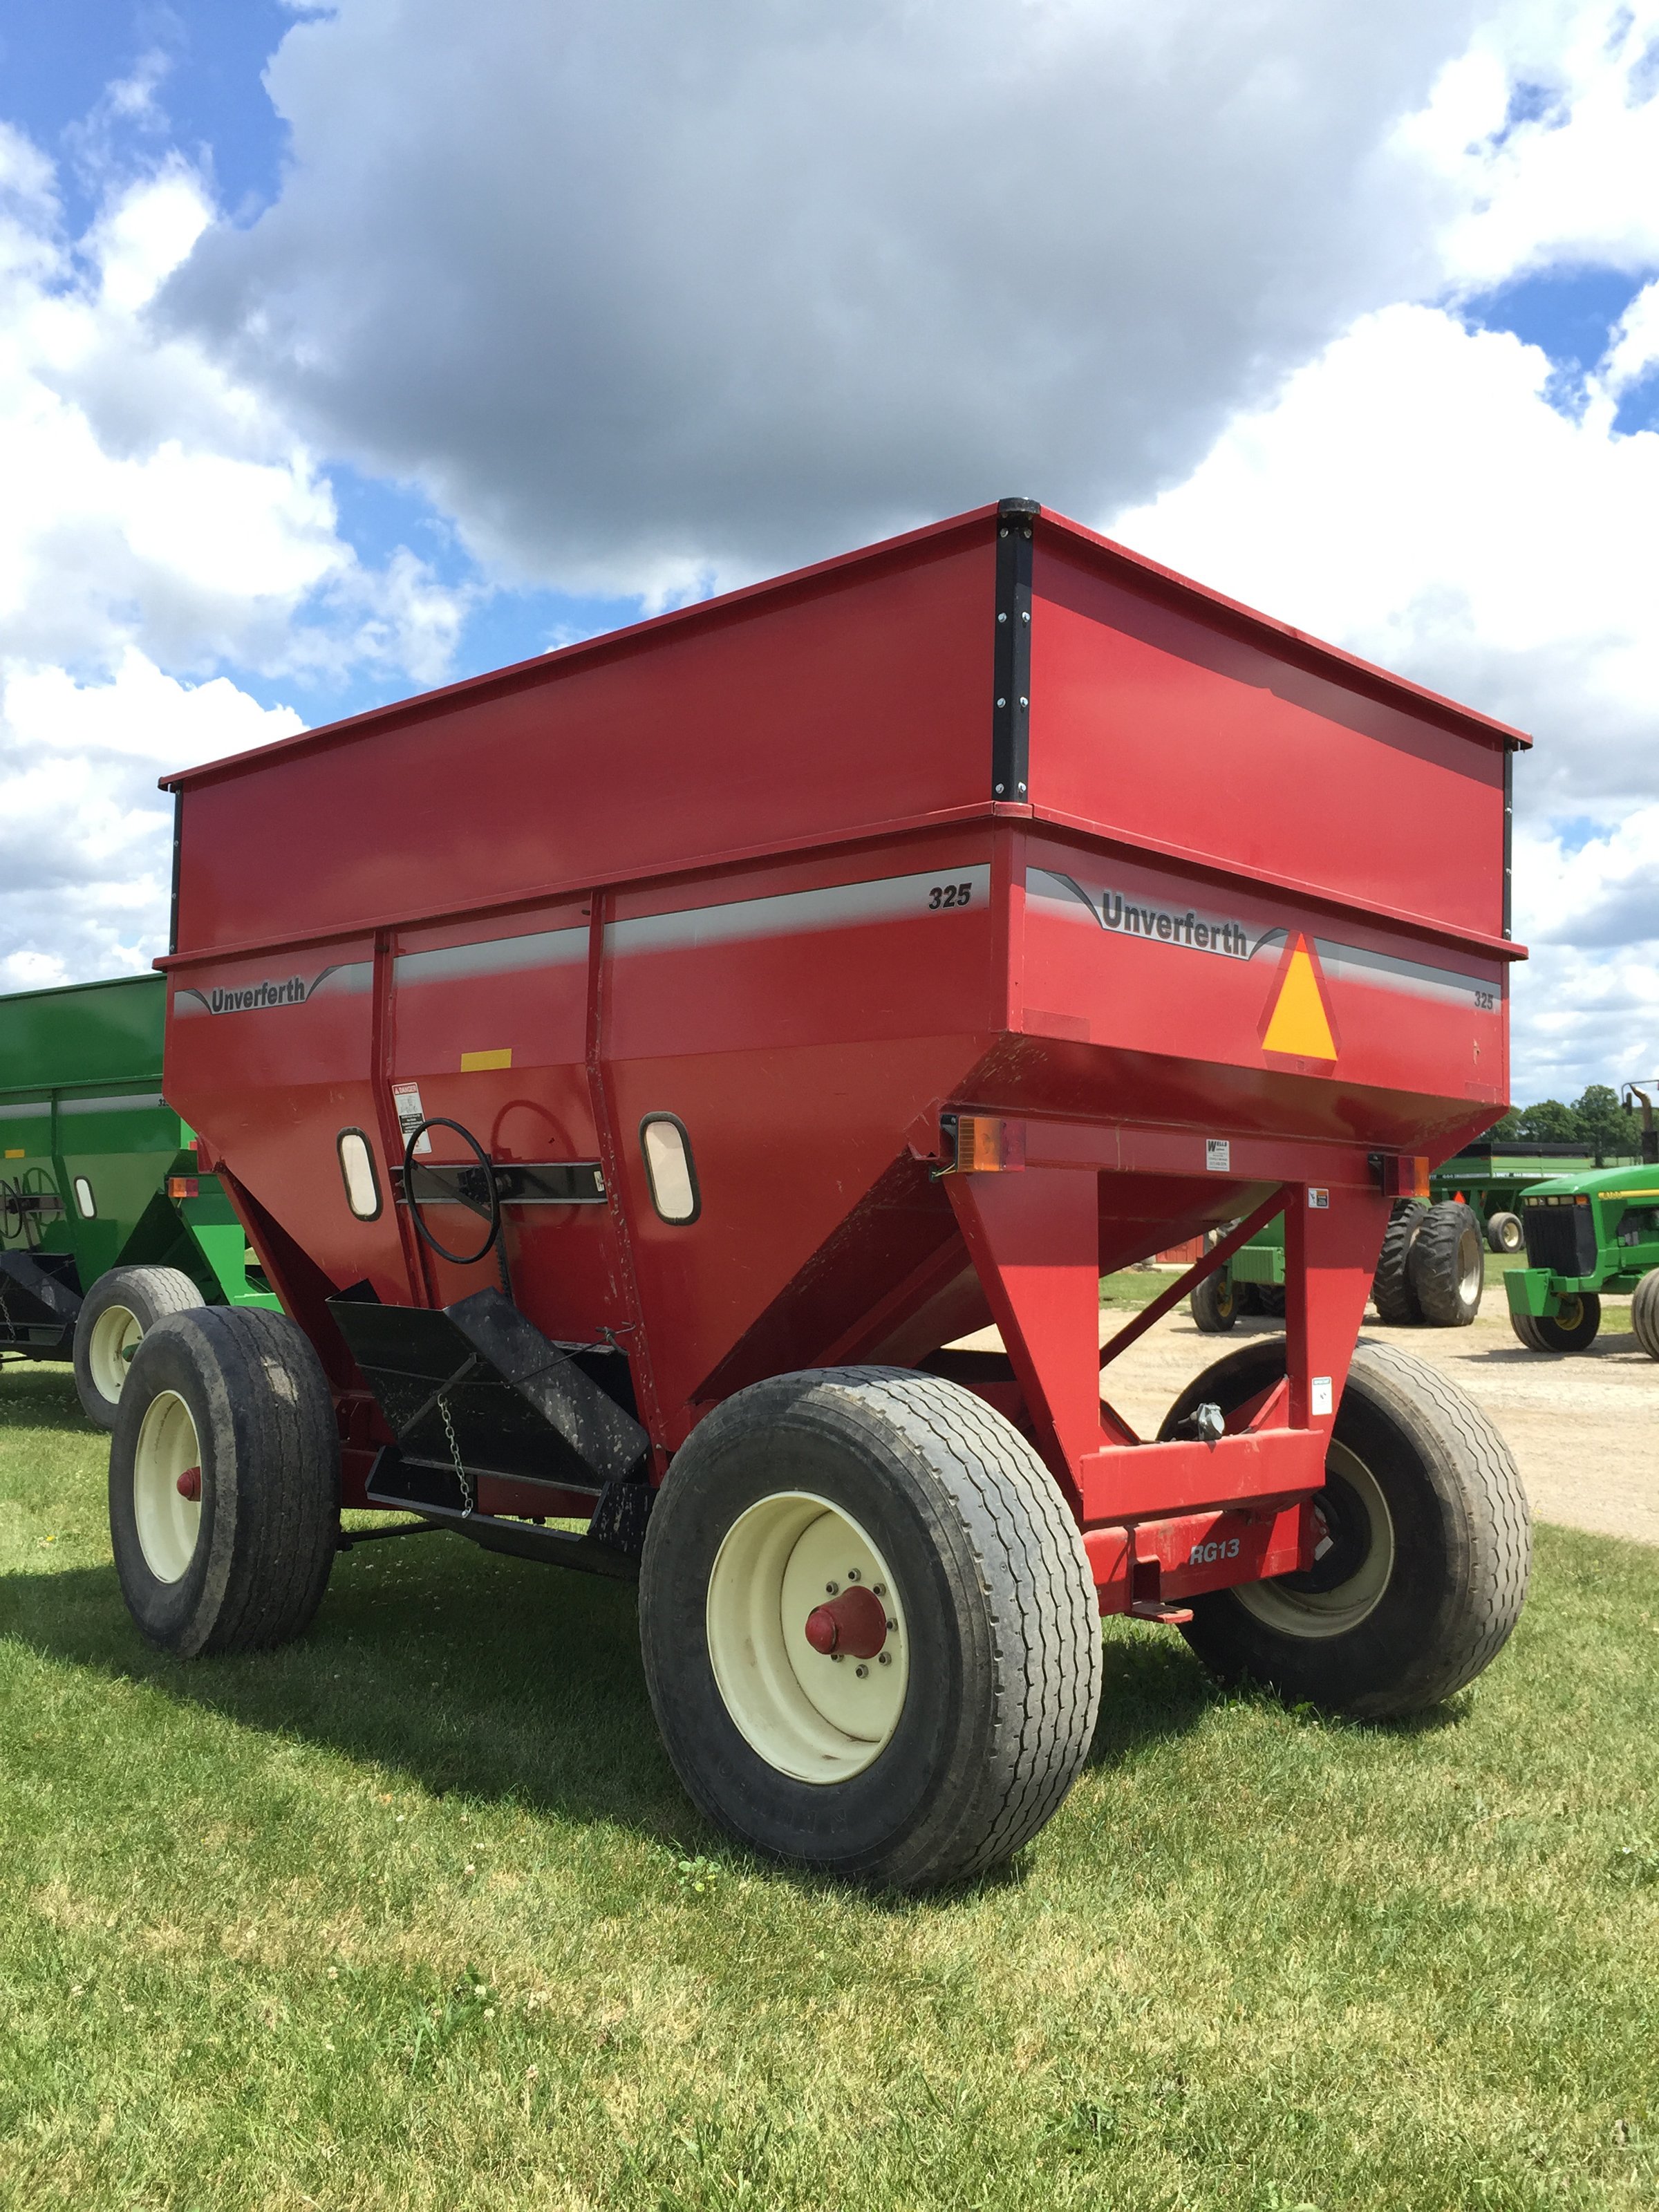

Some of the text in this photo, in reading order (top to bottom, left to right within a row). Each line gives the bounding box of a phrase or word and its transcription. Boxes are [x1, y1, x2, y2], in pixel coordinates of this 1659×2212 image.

[928, 882, 972, 910] 325
[1103, 892, 1247, 957] Unverferth
[212, 977, 305, 1012] Unverferth
[1474, 991, 1494, 1009] 325
[1190, 1539, 1240, 1566] RG13
